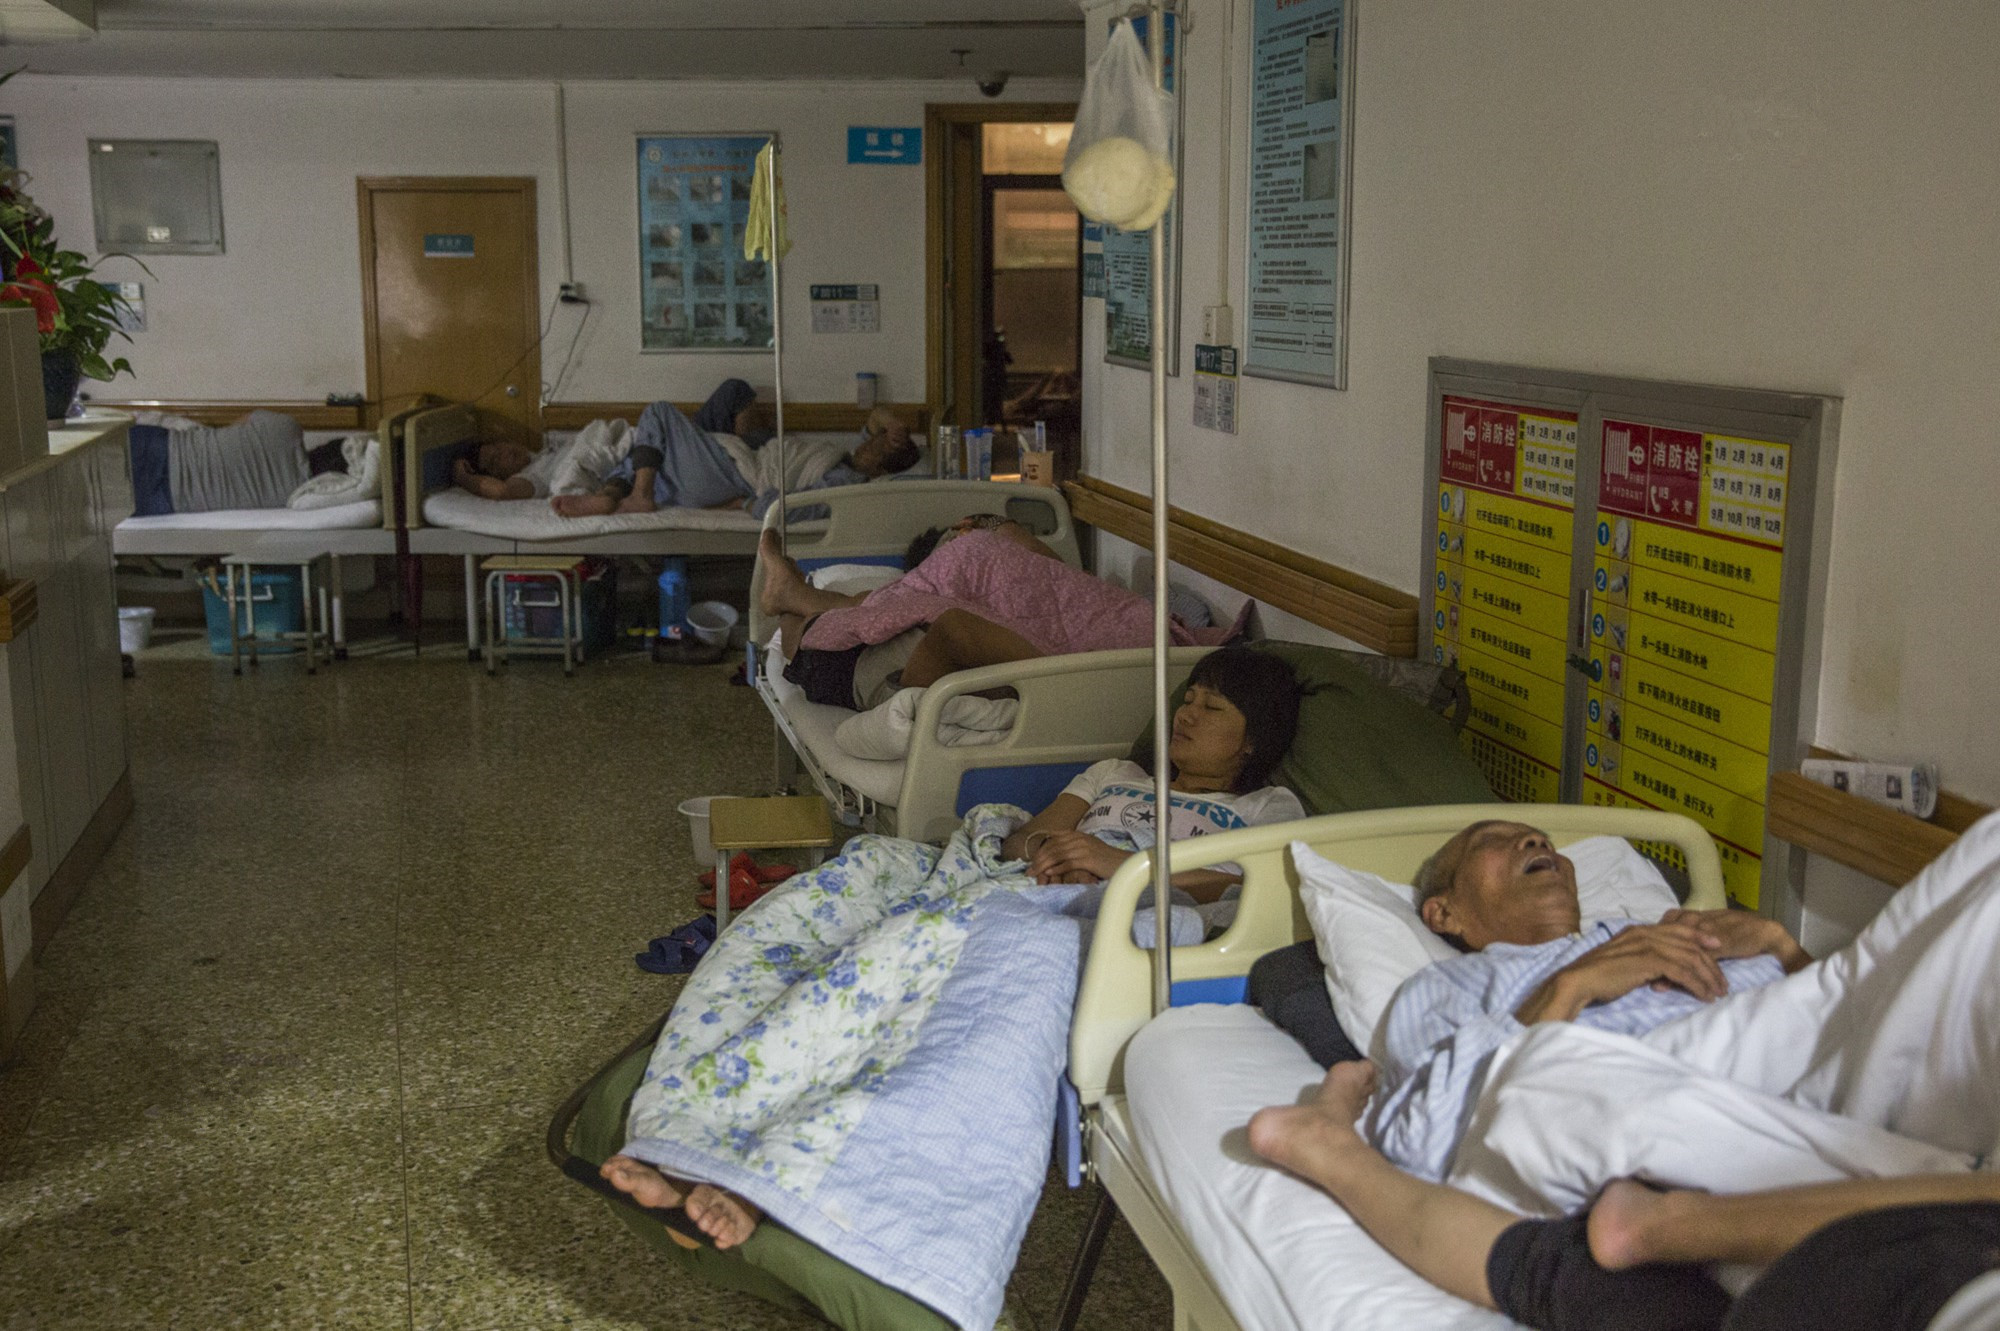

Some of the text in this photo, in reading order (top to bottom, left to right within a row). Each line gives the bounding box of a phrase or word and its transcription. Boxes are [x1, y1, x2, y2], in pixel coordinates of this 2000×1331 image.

[1481, 421, 1516, 447] 消防栓
[1526, 425, 1576, 443] 1月 2月 3月 4月
[1525, 450, 1535, 463] 5月
[1537, 452, 1547, 466] 6月
[1550, 455, 1560, 468] 7月
[1652, 441, 1699, 473] 消防栓
[1715, 447, 1784, 469] 1月 2月 3月 4月
[1535, 478, 1547, 492] 10月
[1548, 481, 1560, 495] 11月
[1561, 483, 1573, 498] 12月
[1629, 473, 1644, 484] FIRE
[1713, 477, 1781, 502] 5月 6月 7月 8月
[1711, 507, 1781, 535] 9月 10月 11月 12月
